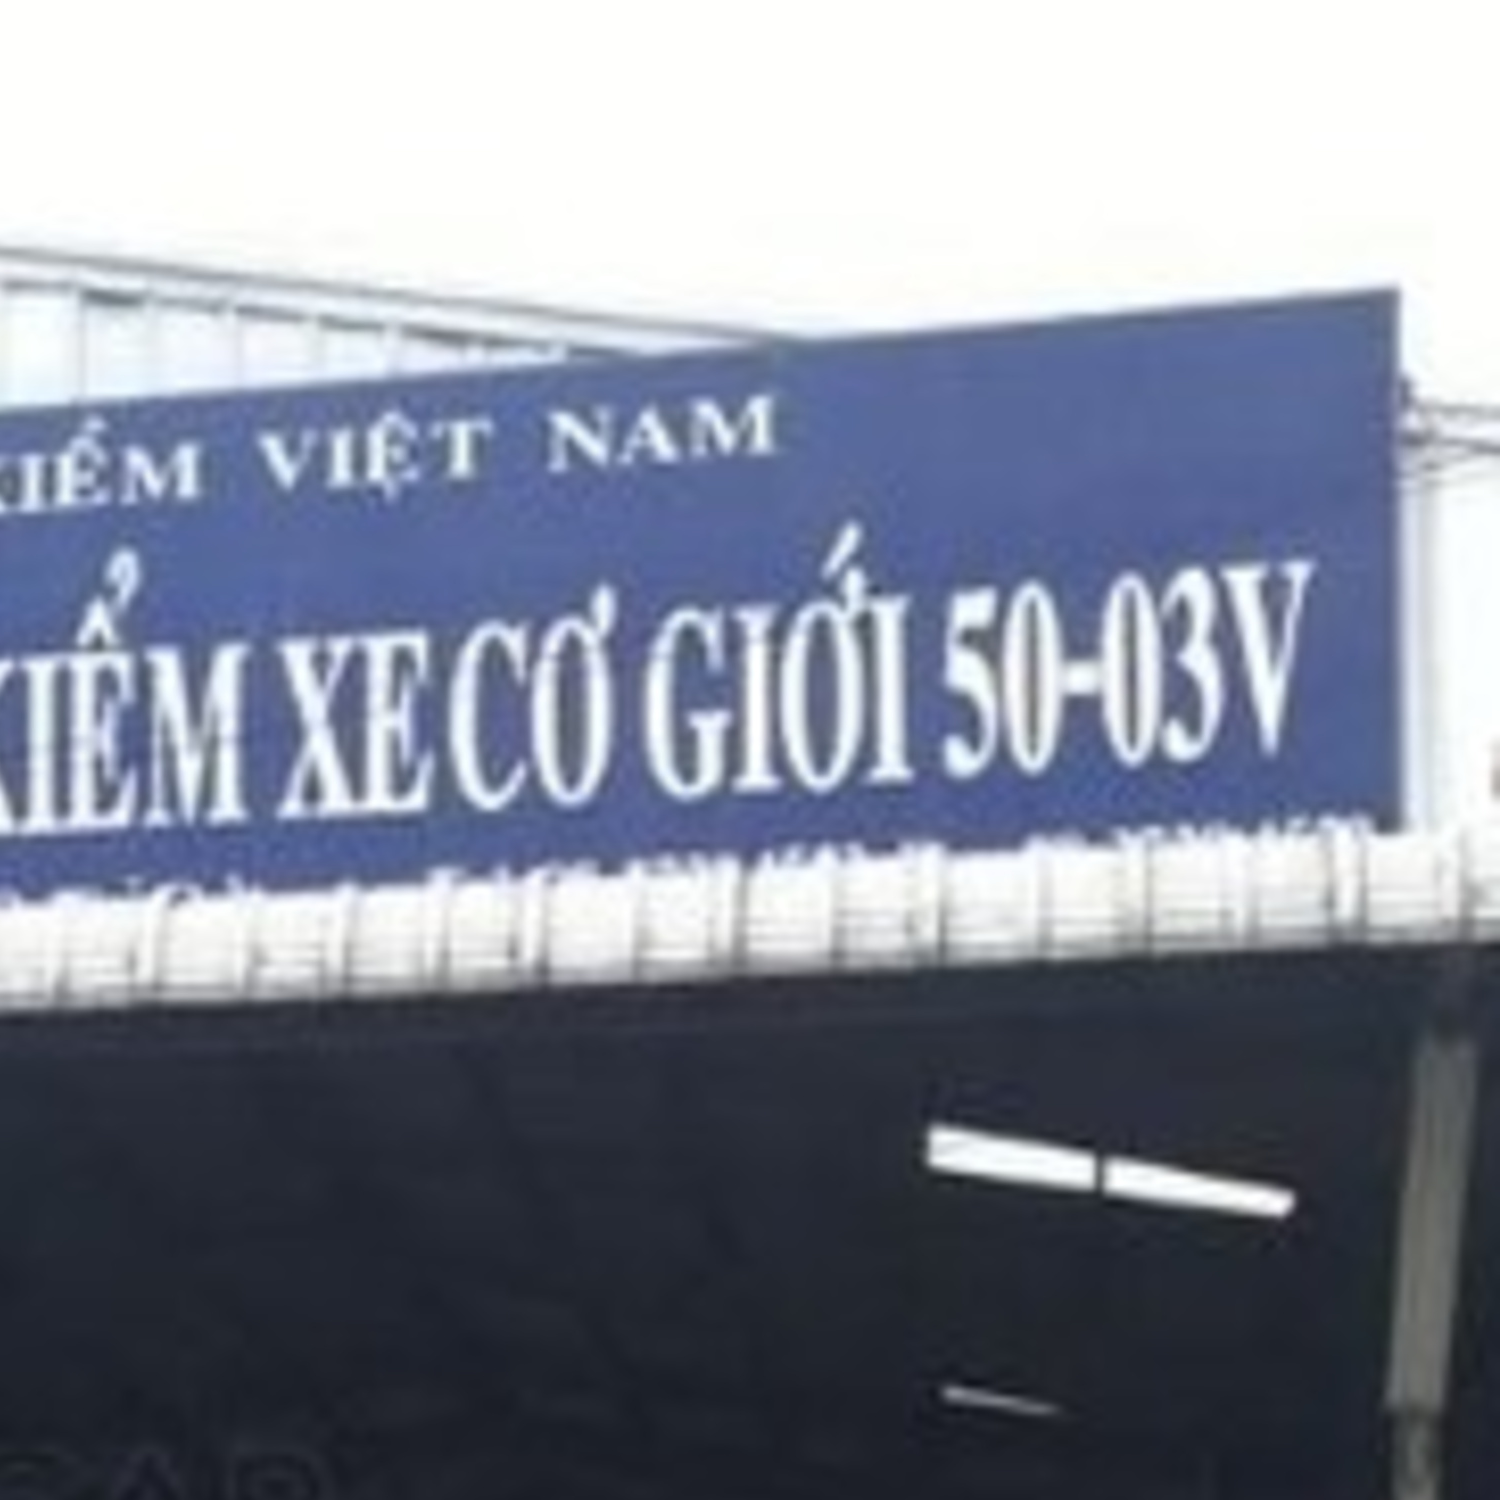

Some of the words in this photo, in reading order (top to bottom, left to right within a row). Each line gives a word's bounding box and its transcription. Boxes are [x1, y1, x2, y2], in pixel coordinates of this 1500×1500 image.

[258, 410, 494, 497] VIỆT
[548, 394, 777, 472] NAM
[276, 629, 435, 820] XE
[448, 584, 617, 812] CƠ
[642, 522, 914, 801] GIỚI
[942, 559, 1315, 779] 50-03V
